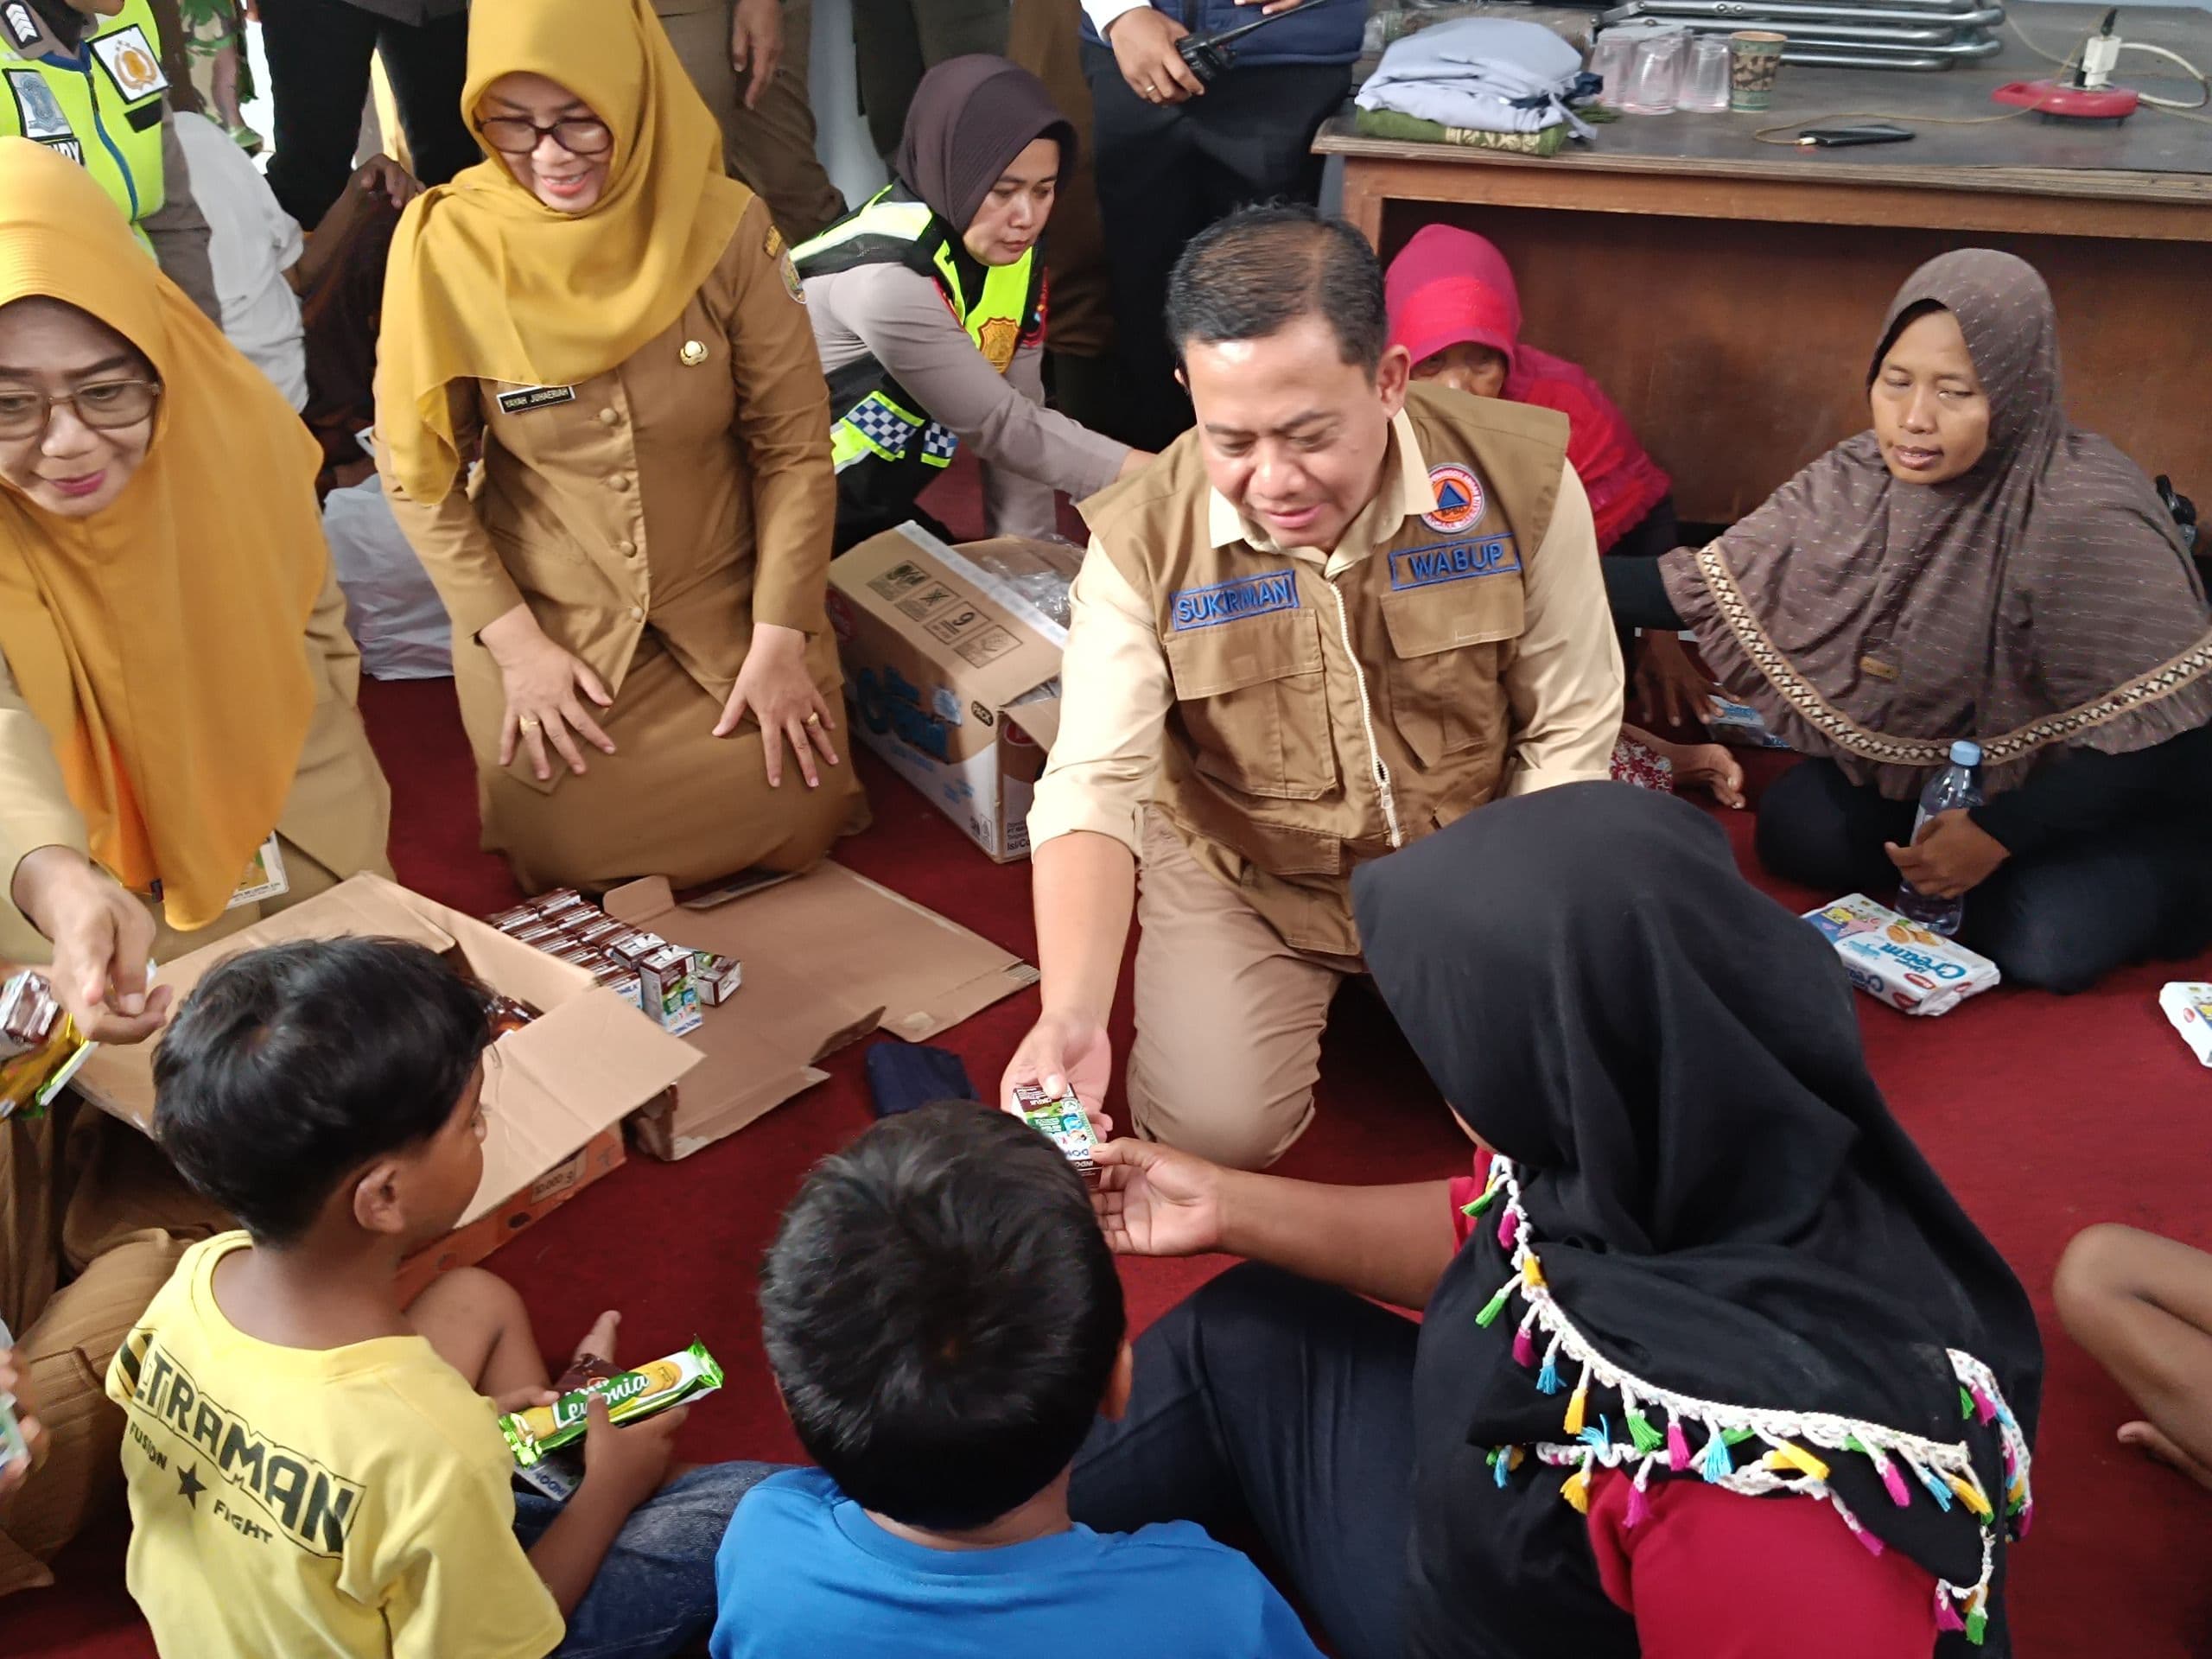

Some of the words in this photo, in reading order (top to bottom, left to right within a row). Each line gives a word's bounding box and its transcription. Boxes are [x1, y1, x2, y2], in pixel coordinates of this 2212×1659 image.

[1409, 543, 1504, 580] WABUP
[1879, 942, 1967, 979] Cream
[130, 1422, 168, 1470] FUSION
[213, 1499, 273, 1543] FIGHT
